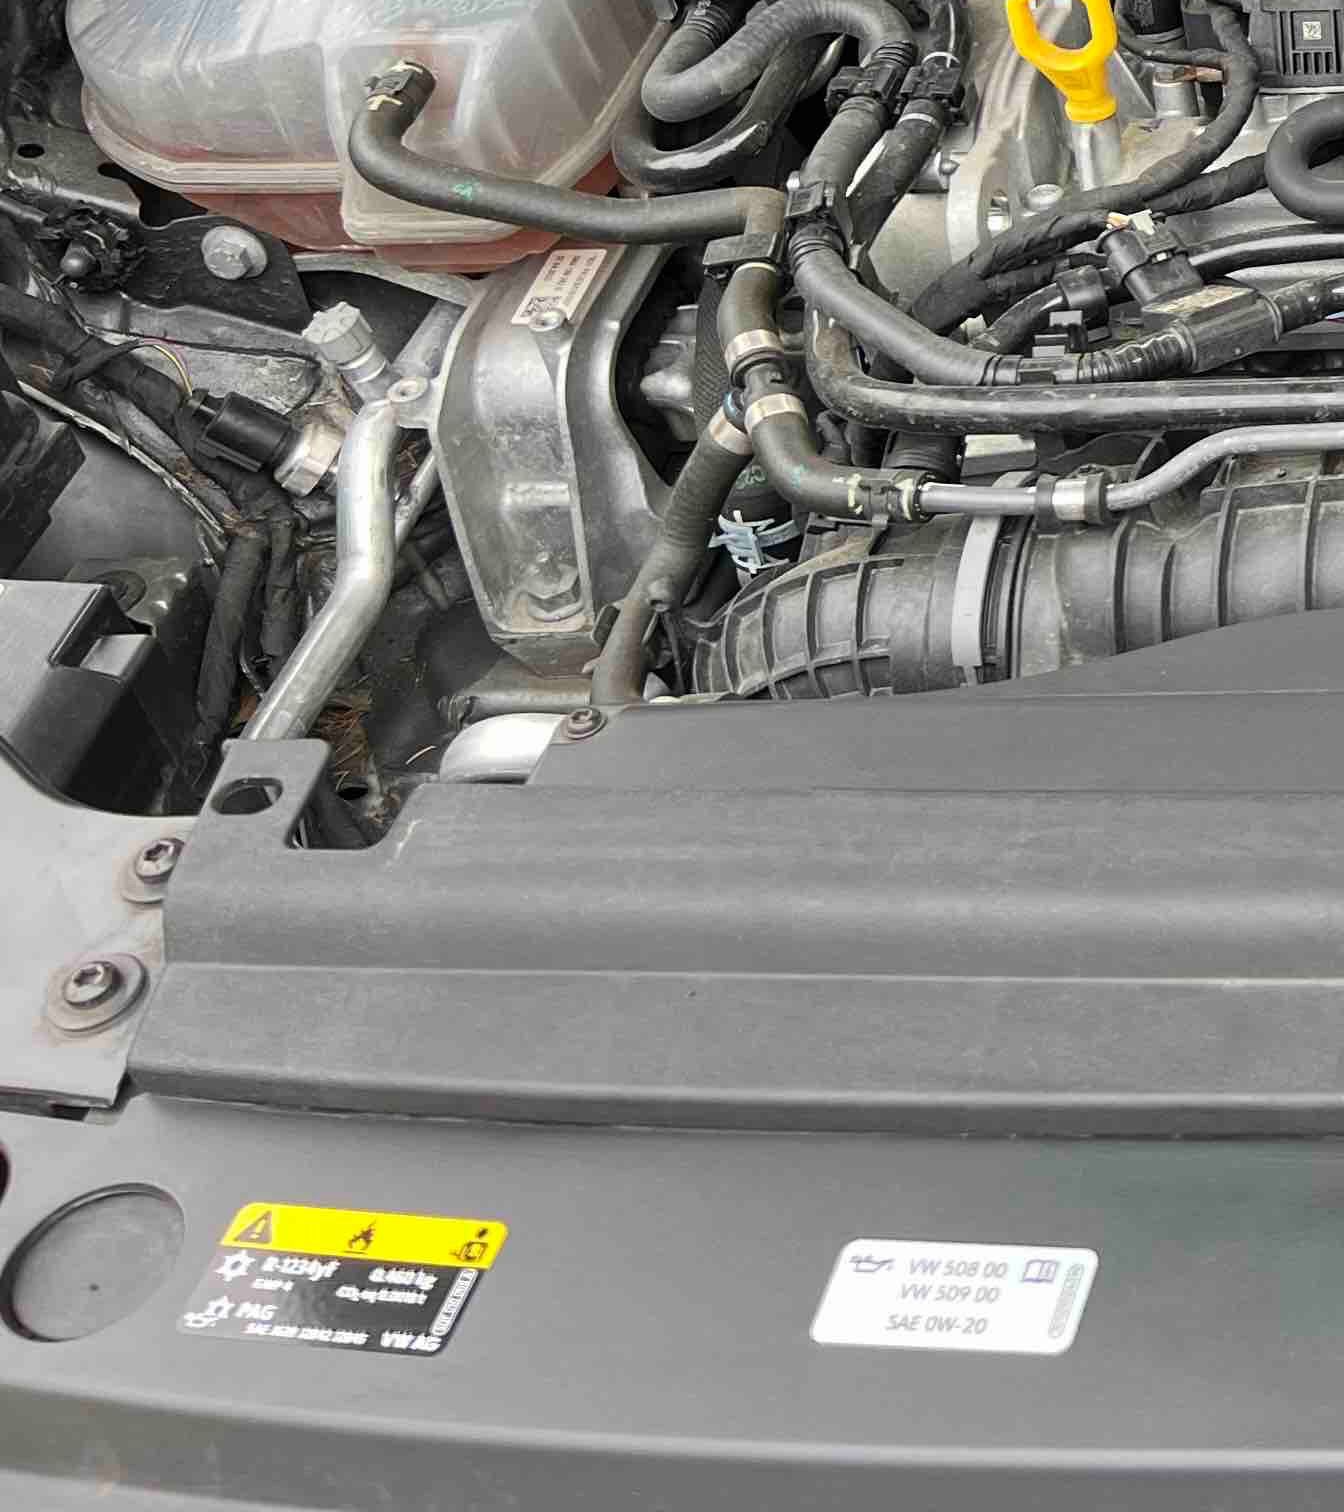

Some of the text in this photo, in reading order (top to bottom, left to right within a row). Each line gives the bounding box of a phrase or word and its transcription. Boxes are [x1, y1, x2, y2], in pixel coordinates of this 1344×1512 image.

[908, 1258, 1008, 1278] VW 508 00
[899, 1284, 1002, 1303] VW 509 00
[235, 1301, 278, 1321] PAG
[885, 1314, 988, 1335] SAE 0W-20
